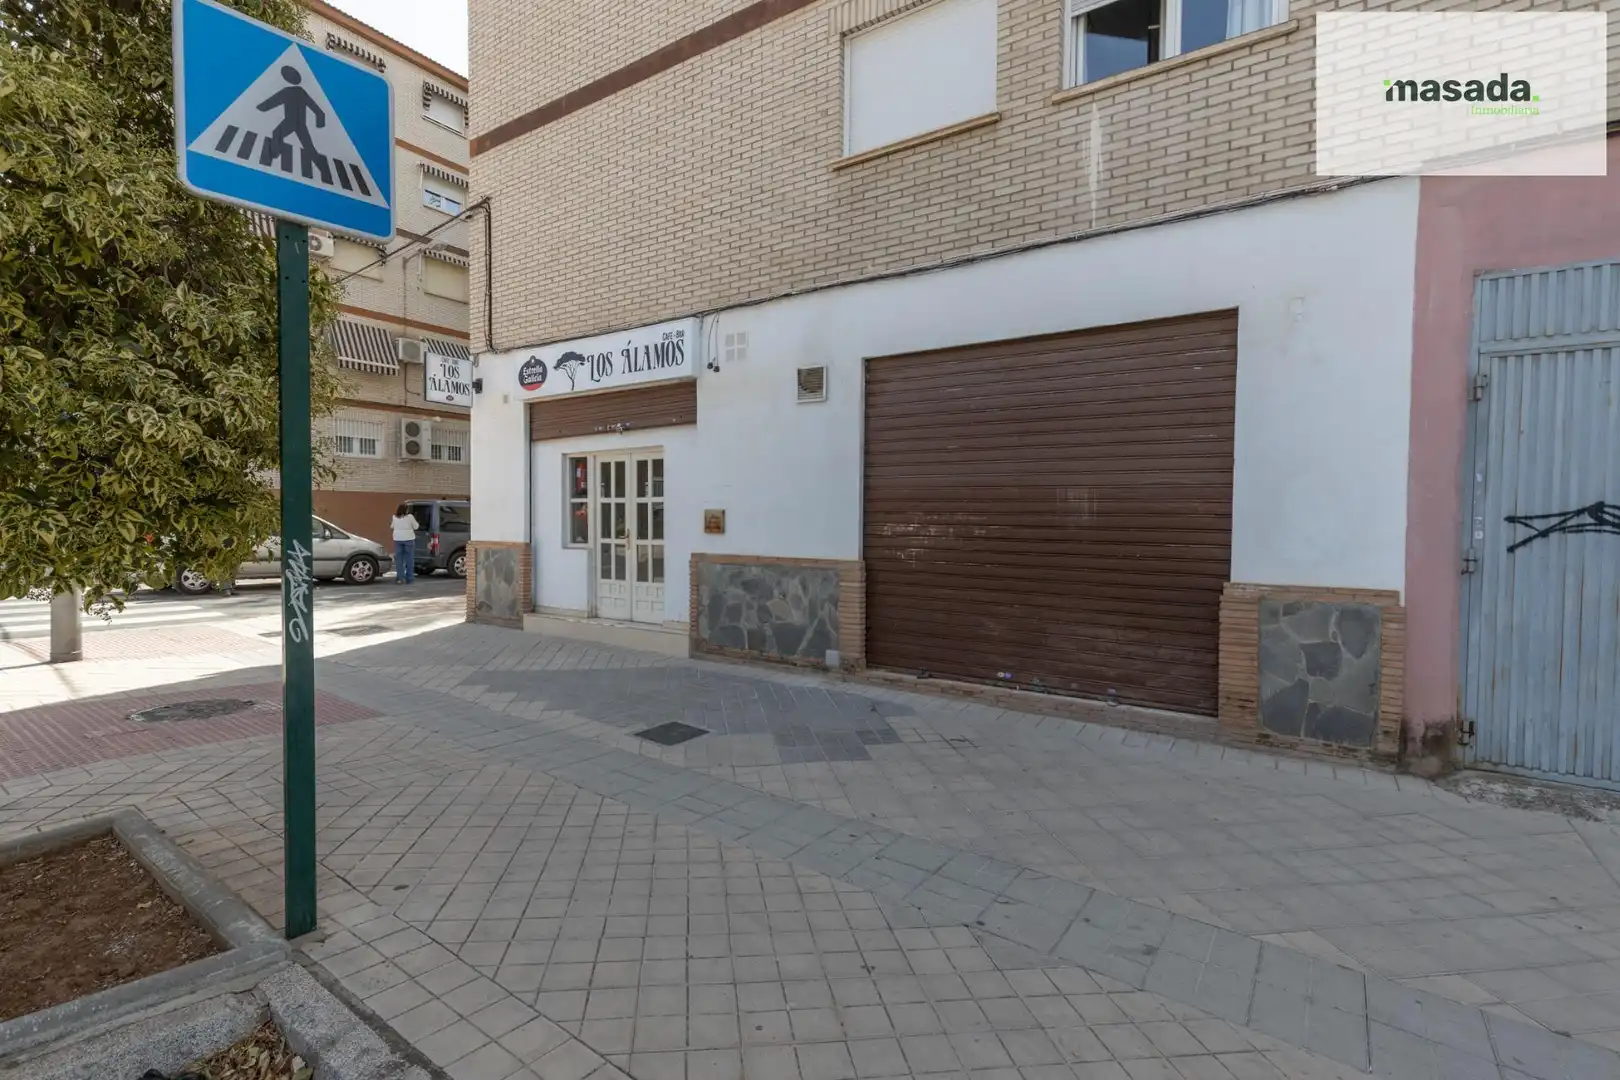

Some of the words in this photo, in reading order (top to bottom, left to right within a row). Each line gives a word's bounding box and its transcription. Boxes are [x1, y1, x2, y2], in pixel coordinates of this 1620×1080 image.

[587, 351, 613, 382] LOS
[621, 340, 685, 374] ÁLAMOS
[440, 363, 460, 379] LOS
[523, 365, 543, 376] Estrella
[429, 373, 470, 396] ÁLAMOS
[523, 374, 542, 384] Galicia
